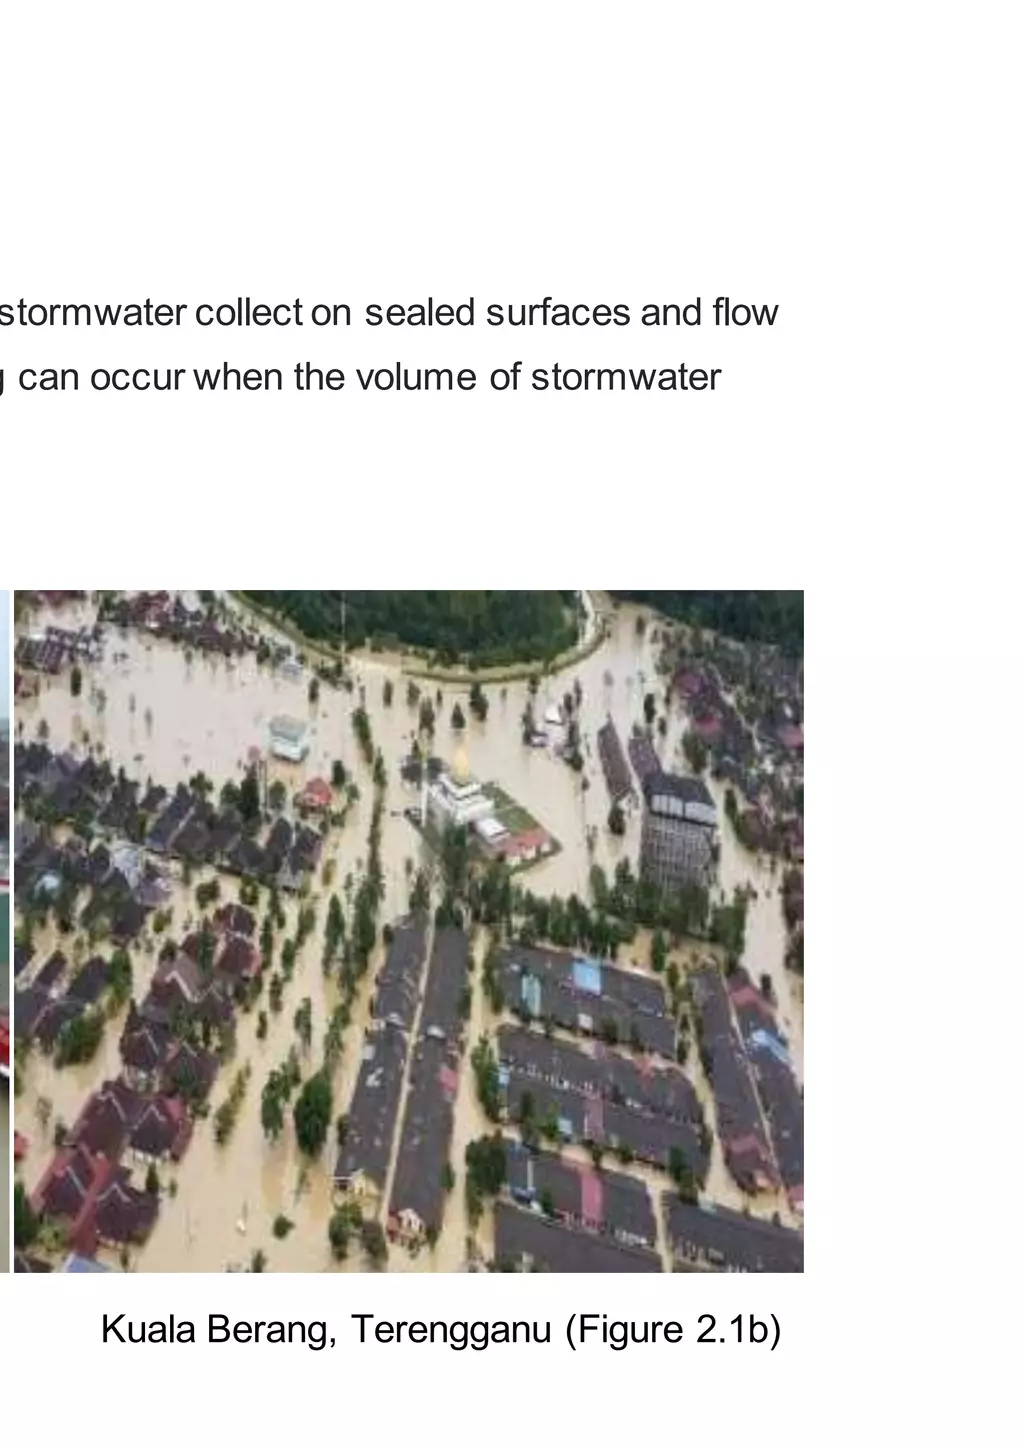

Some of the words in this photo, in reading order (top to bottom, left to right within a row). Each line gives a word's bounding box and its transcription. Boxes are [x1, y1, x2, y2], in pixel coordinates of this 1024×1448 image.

[196, 297, 303, 326] collect
[312, 304, 350, 326] on
[366, 297, 474, 326] sealed
[487, 297, 630, 326] surfaces
[642, 297, 700, 326] and
[713, 297, 779, 326] flow
[19, 369, 78, 390] can
[91, 369, 186, 390] occur
[193, 362, 282, 390] when
[294, 362, 345, 390] the
[356, 362, 476, 390] volume
[491, 361, 522, 390] of
[532, 363, 722, 390] stormwater
[103, 1314, 195, 1343] Kuala
[209, 1314, 335, 1350] Berang,
[351, 1314, 550, 1350] Terengganu
[567, 1314, 683, 1351] (Figure
[697, 1314, 780, 1351] 2.1b)
